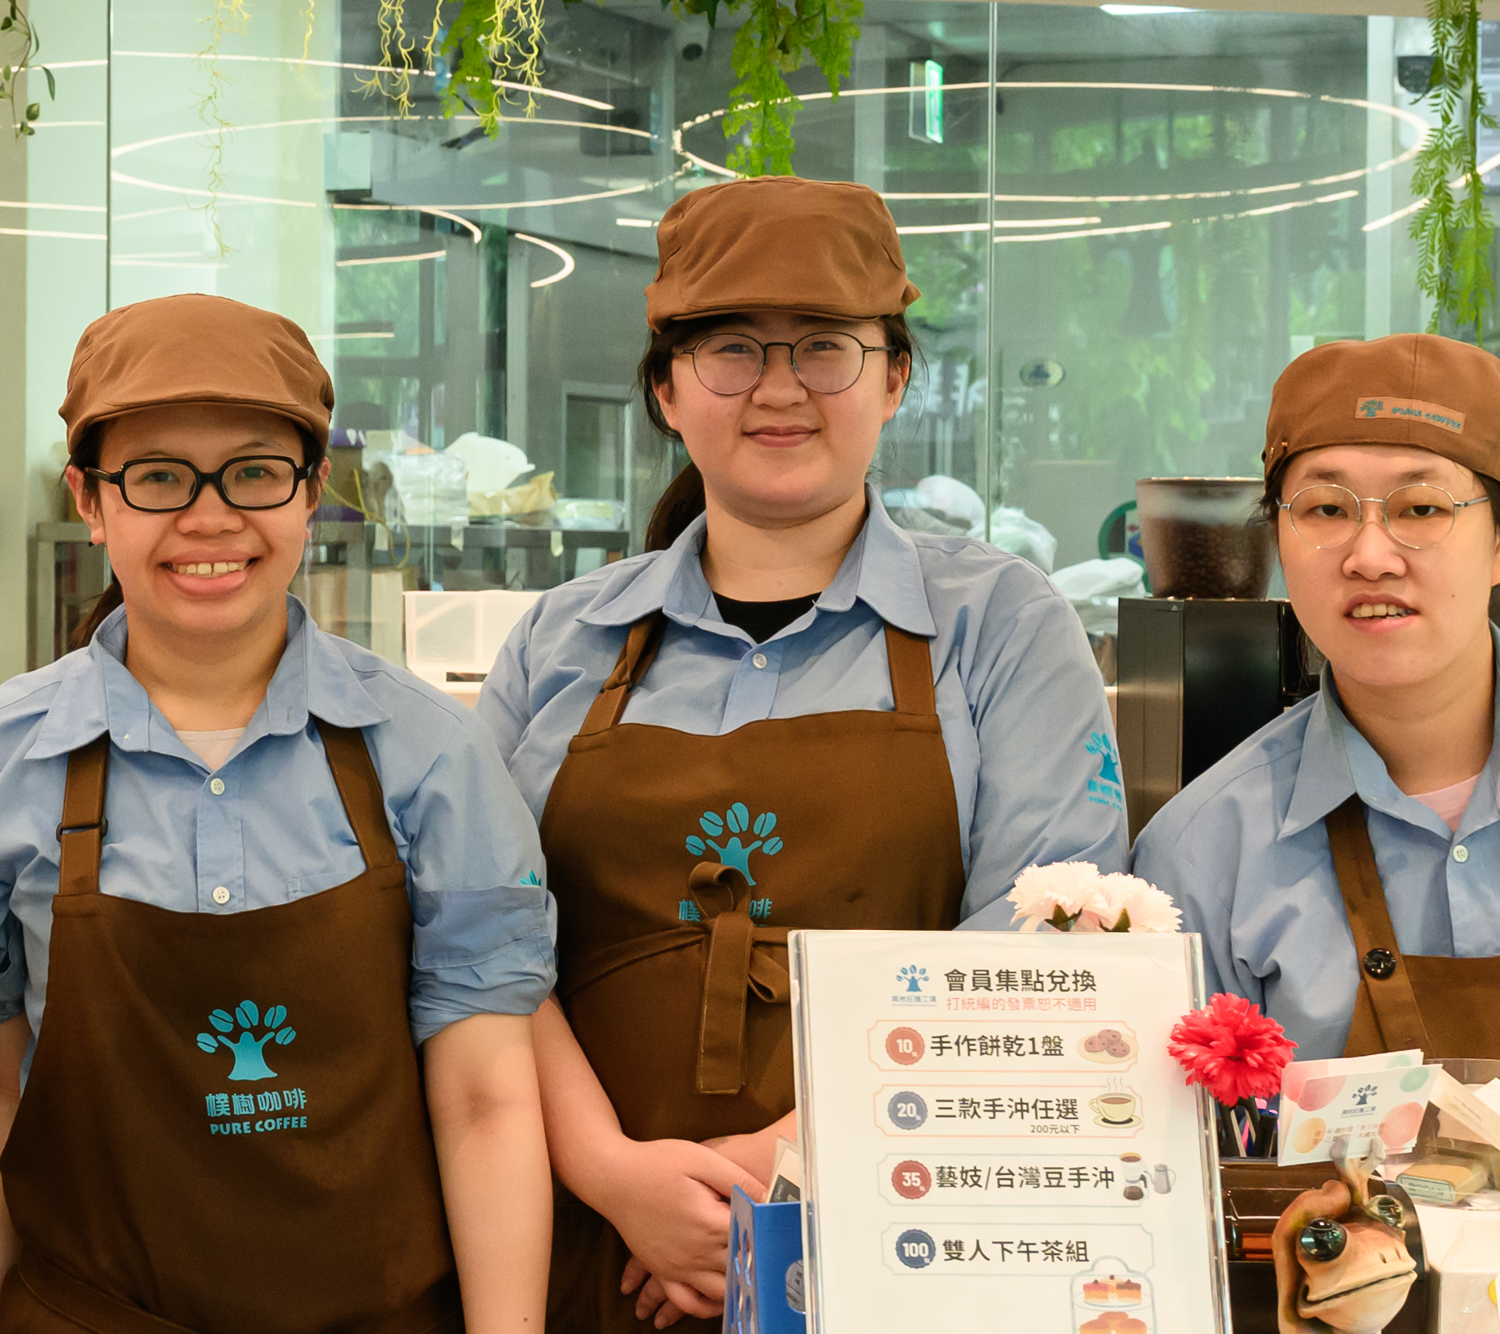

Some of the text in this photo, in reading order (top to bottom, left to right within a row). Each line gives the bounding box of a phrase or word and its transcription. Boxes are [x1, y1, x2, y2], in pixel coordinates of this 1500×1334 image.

[678, 898, 773, 922] 樸啡
[943, 968, 1098, 993] 會員集點兌換
[946, 997, 1098, 1011] 打統編的發票恕不適用
[896, 1038, 912, 1053] 10
[930, 1034, 1064, 1057] 手作餅乾1盤
[897, 1102, 917, 1118] 20
[935, 1098, 1080, 1120] 三款手沖任選
[210, 1116, 308, 1136] PURE COFFEE
[1030, 1124, 1080, 1134] 200元以下
[901, 1172, 922, 1187] 35
[935, 1165, 1115, 1192] 藝妓/台灣豆手沖
[901, 1242, 929, 1258] 100
[942, 1238, 1090, 1265] 雙人下午茶組
